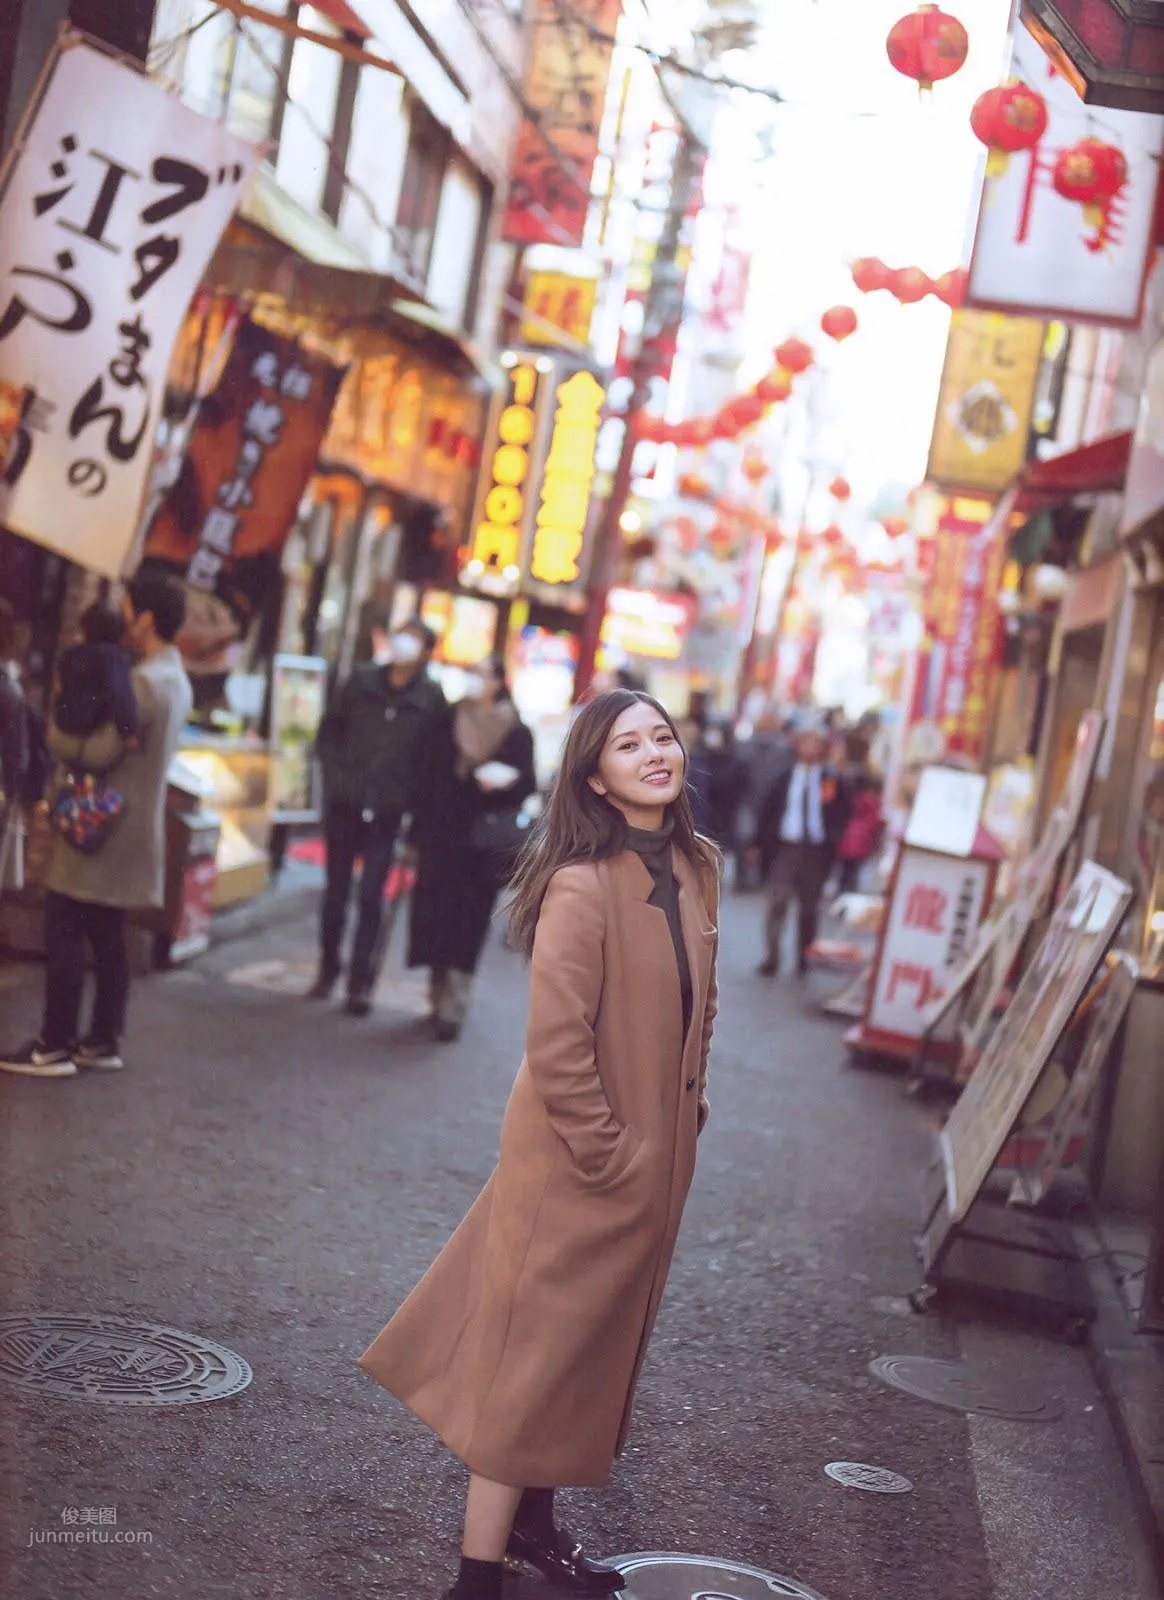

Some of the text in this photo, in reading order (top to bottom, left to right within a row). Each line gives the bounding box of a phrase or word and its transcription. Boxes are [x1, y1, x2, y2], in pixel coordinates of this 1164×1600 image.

[0, 134, 143, 490] 江戸
[67, 156, 244, 497] ブタまんの
